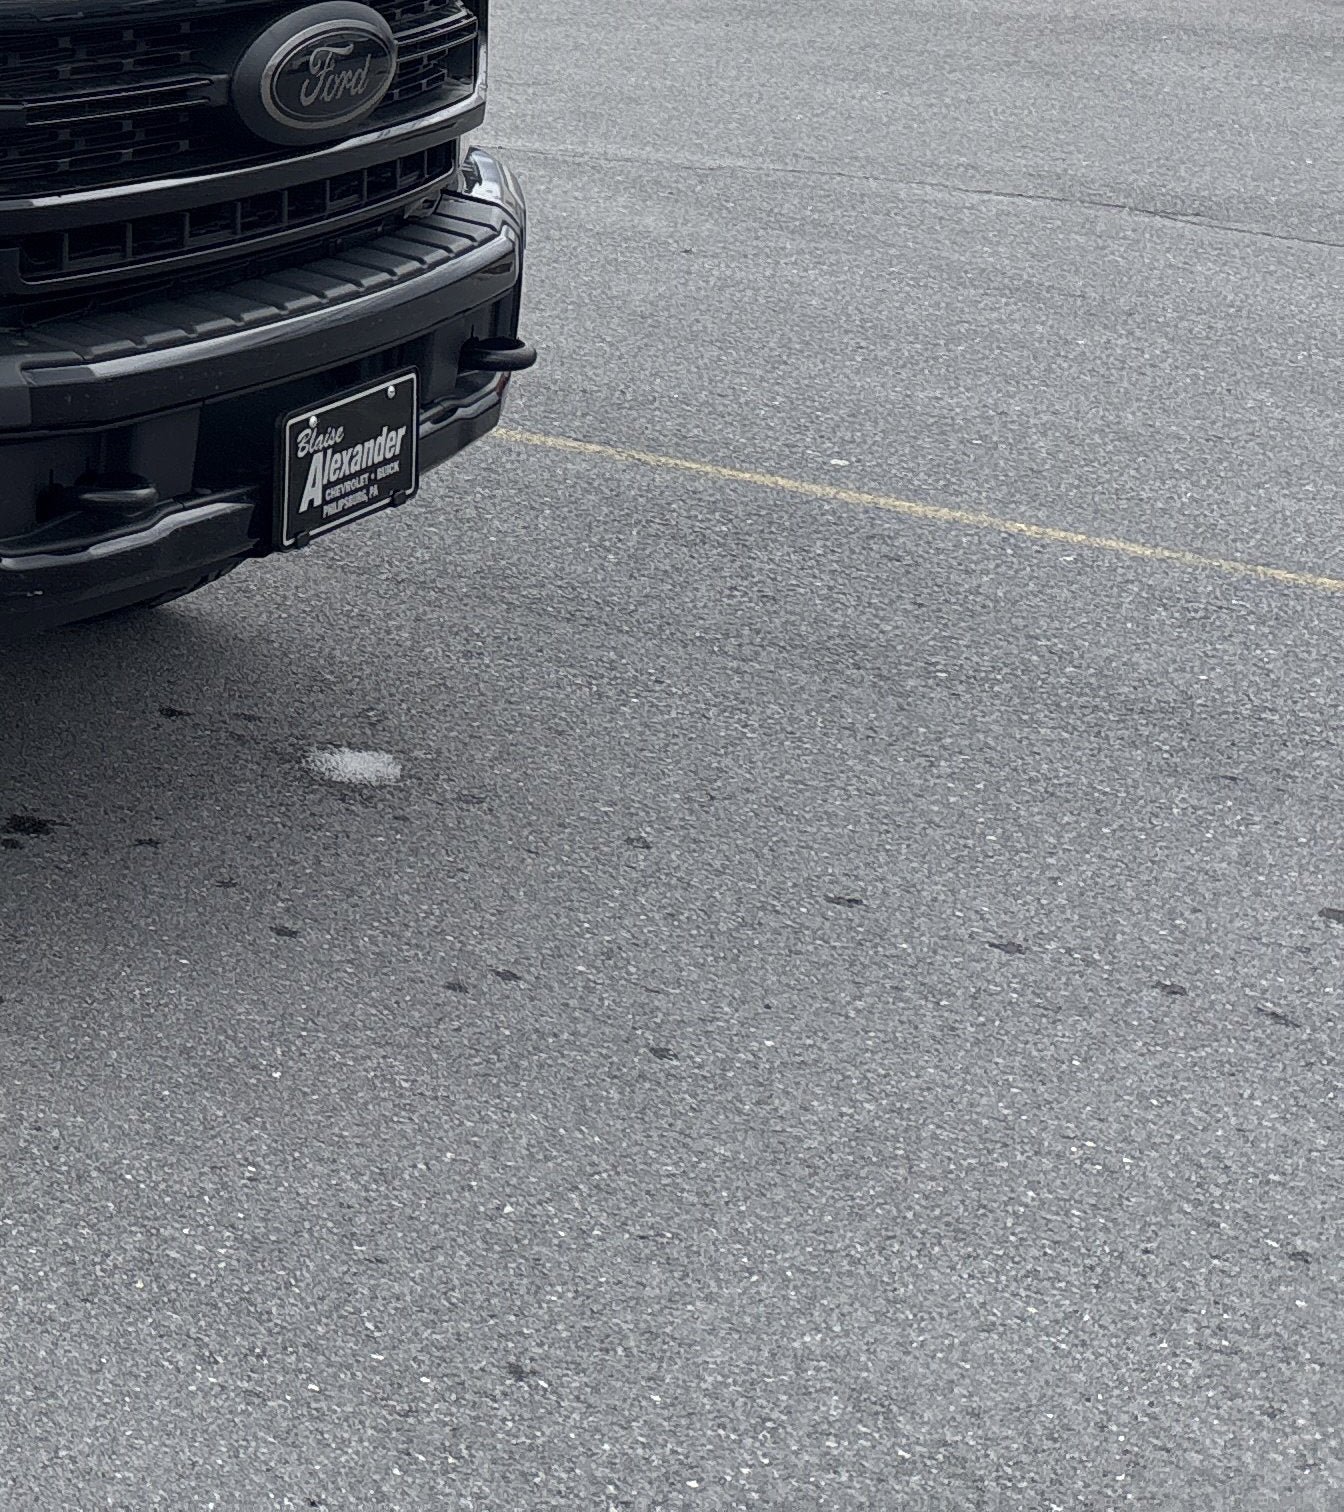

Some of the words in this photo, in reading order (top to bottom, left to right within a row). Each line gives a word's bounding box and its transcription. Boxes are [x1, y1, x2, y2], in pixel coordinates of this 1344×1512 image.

[299, 42, 373, 107] Ford
[297, 426, 344, 458] Blaise
[299, 426, 407, 514] Alexander
[325, 473, 369, 500] CHEVROLET
